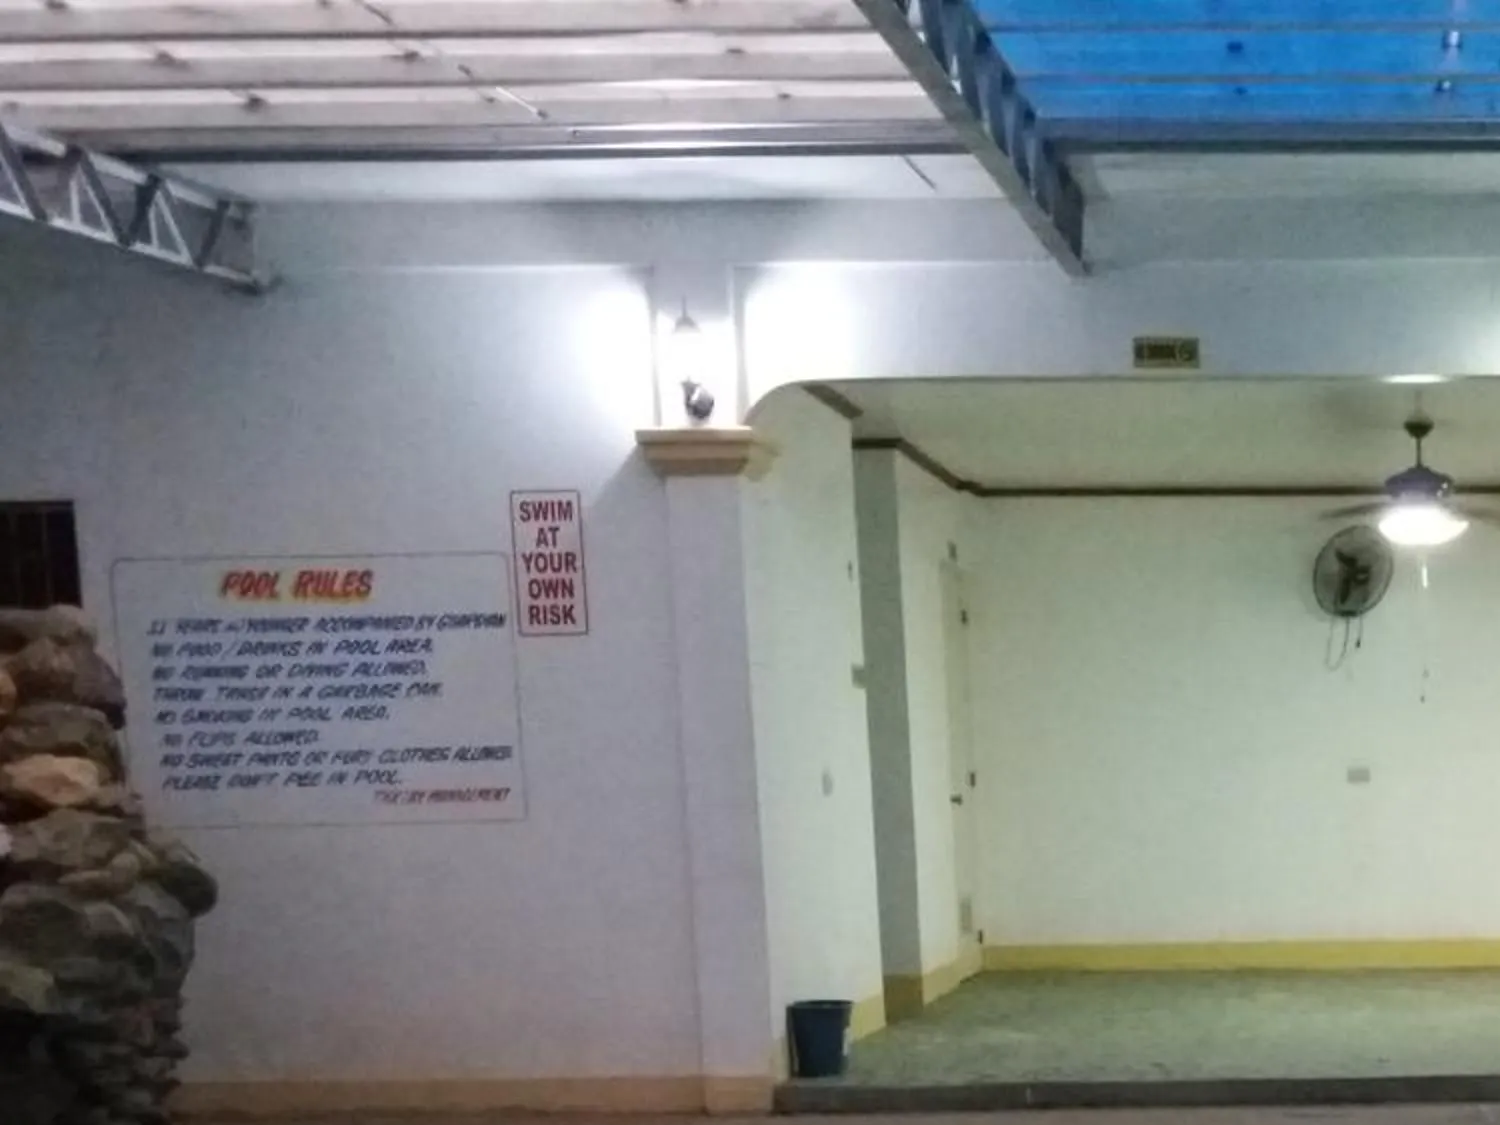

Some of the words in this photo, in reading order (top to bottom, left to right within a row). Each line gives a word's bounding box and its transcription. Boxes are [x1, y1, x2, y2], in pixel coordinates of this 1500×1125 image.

[519, 500, 573, 522] SWIM
[536, 527, 560, 547] AT
[522, 551, 577, 573] YOUR
[219, 569, 280, 599] POOL
[292, 568, 373, 600] RULES
[528, 578, 575, 600] OWN
[528, 604, 576, 626] RISK
[334, 637, 381, 655] POOL
[255, 663, 284, 679] OR
[297, 684, 313, 698] A
[286, 705, 331, 722] POOL
[378, 746, 451, 764] CLOTHES
